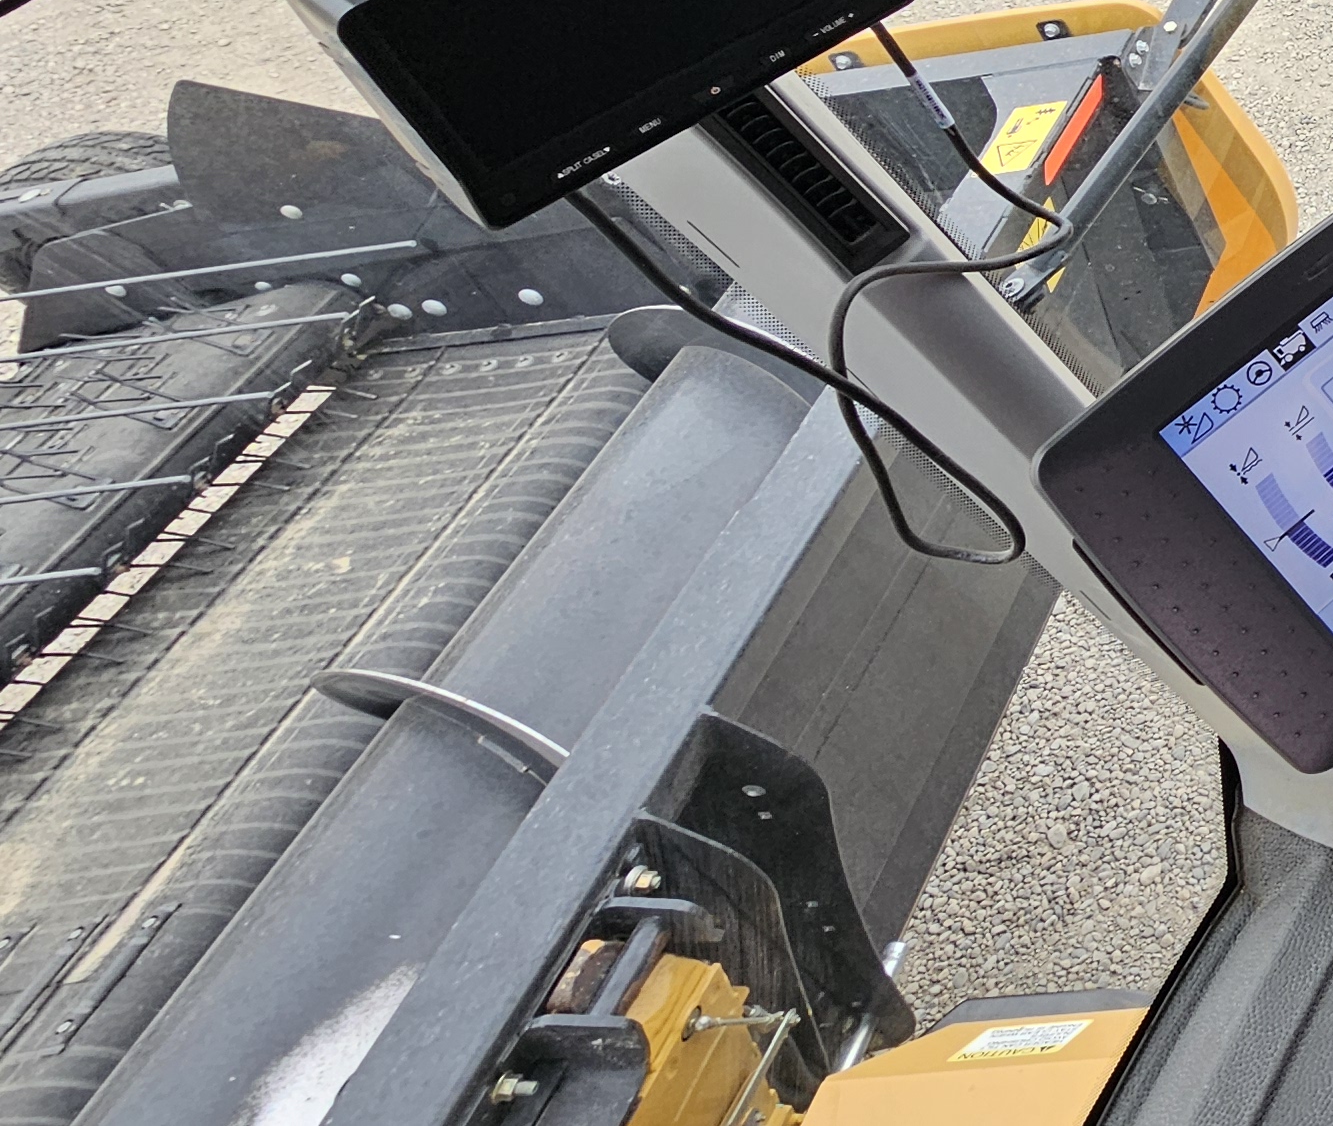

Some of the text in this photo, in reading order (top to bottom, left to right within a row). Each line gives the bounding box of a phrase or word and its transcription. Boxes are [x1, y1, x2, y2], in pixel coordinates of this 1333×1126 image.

[819, 15, 847, 34] VOLUME
[769, 49, 786, 63] DIM
[638, 117, 662, 135] MENU
[561, 159, 582, 177] SPLIT
[957, 1046, 1036, 1060] CAUTION
